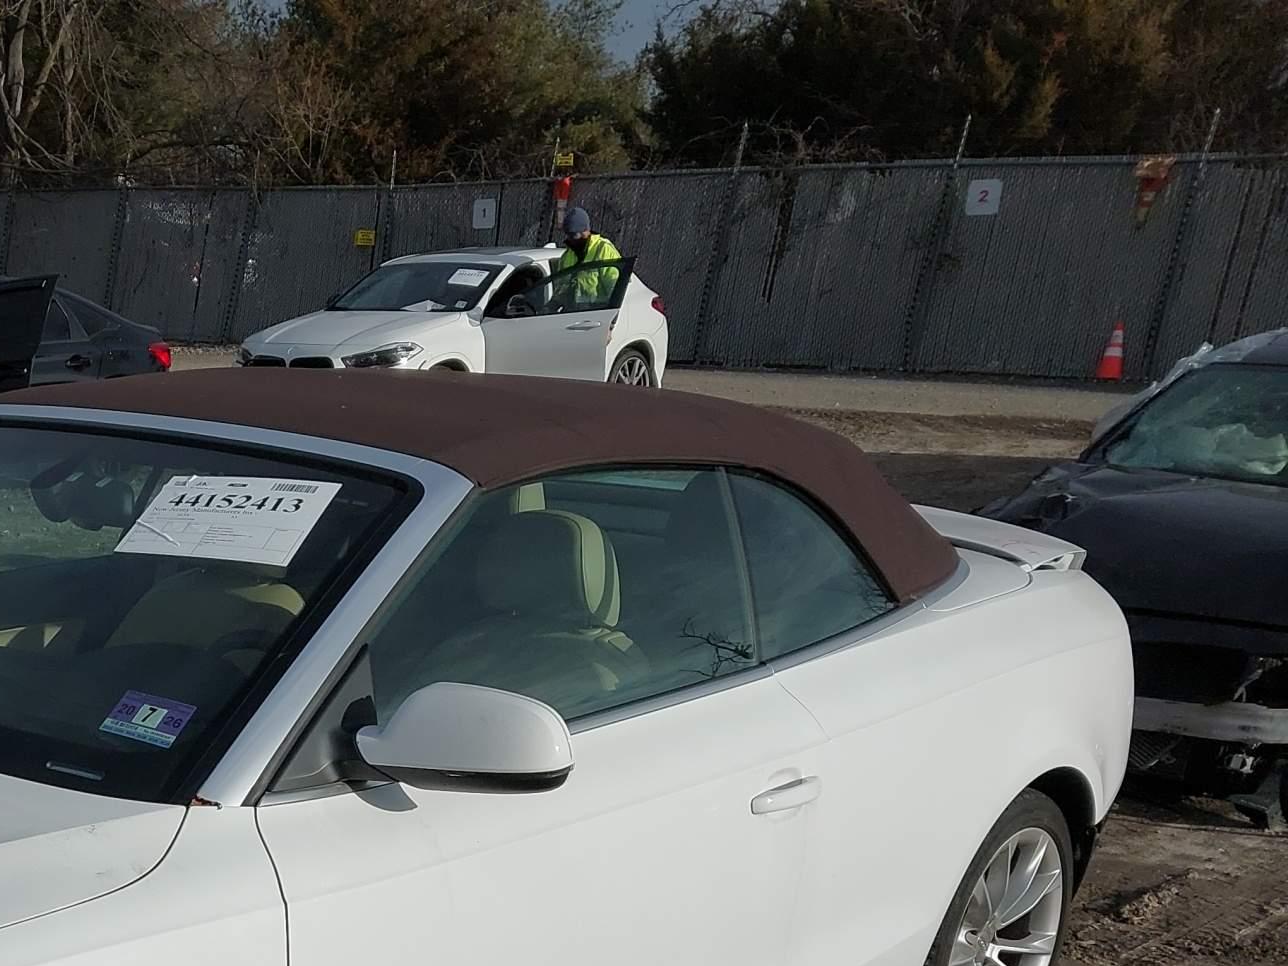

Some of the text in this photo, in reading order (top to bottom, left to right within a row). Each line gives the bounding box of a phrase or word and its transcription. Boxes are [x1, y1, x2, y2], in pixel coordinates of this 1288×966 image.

[978, 190, 989, 202] 2
[481, 207, 487, 218] 1
[168, 493, 304, 513] 44152413
[141, 706, 158, 722] 7
[163, 715, 183, 729] 26
